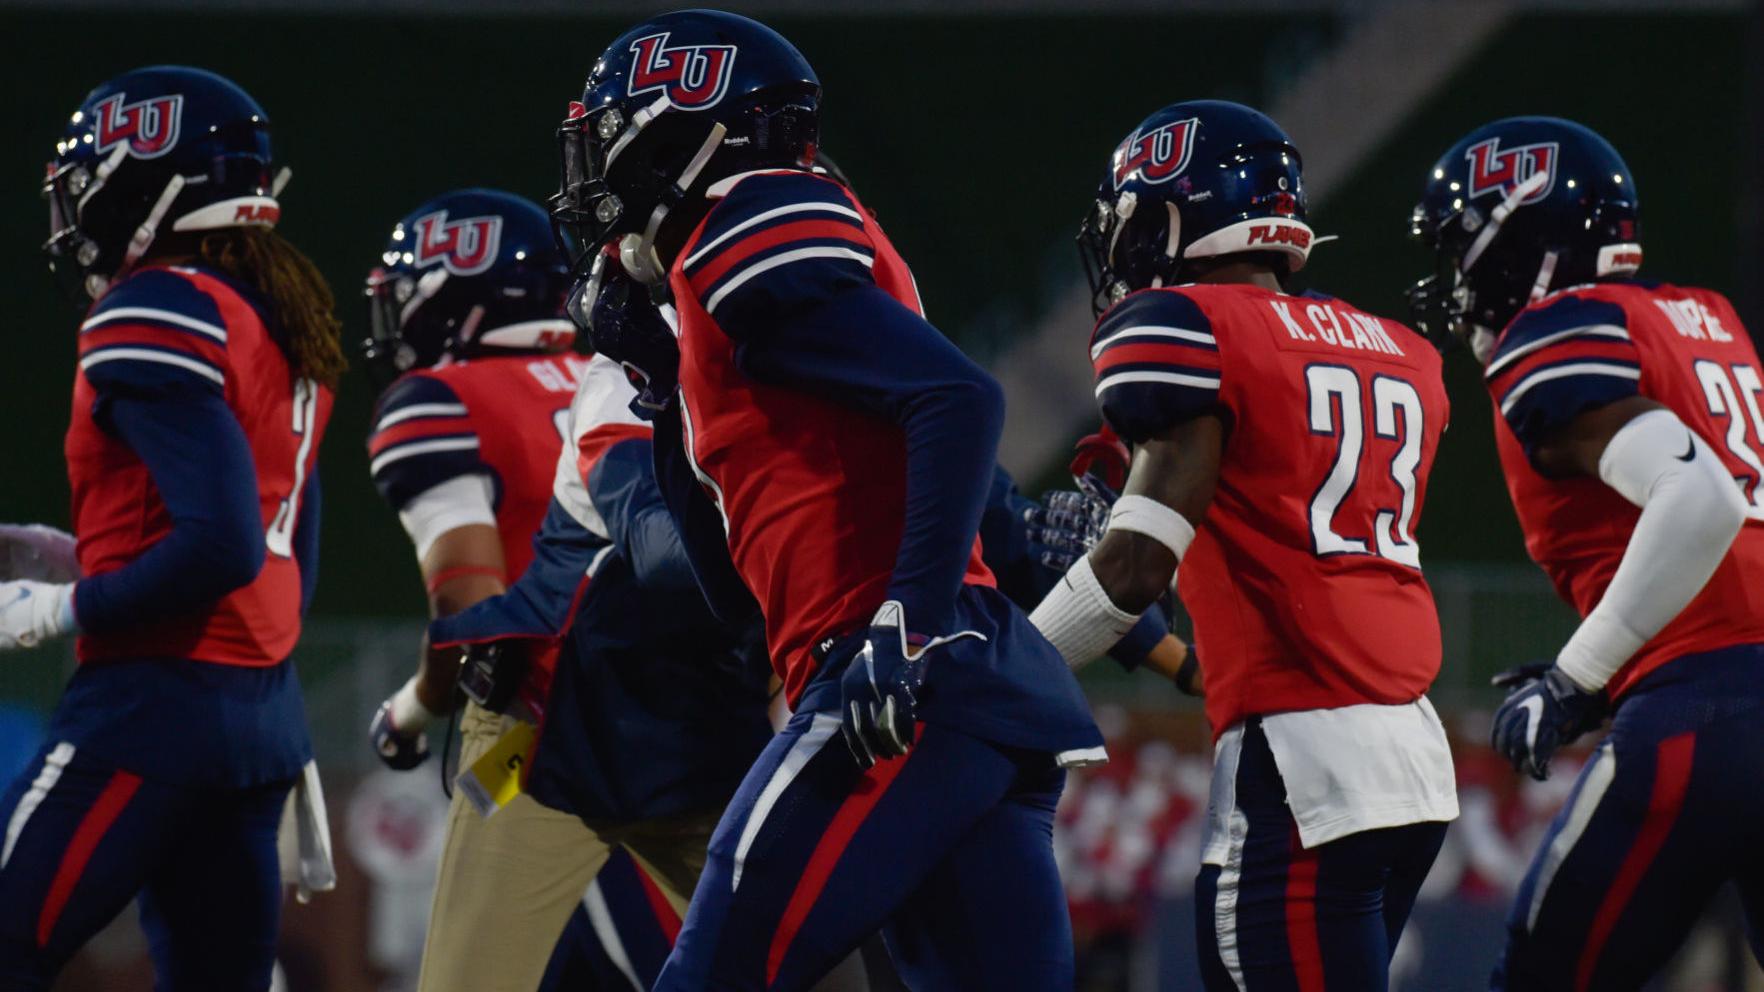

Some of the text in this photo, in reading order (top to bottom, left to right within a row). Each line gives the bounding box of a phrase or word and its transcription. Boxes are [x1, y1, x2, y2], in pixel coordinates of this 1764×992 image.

[627, 32, 738, 112] LU
[92, 91, 184, 161] LU
[1112, 117, 1199, 191] LU
[1465, 137, 1560, 206] LU
[413, 208, 504, 277] LU
[1304, 362, 1424, 570] 23
